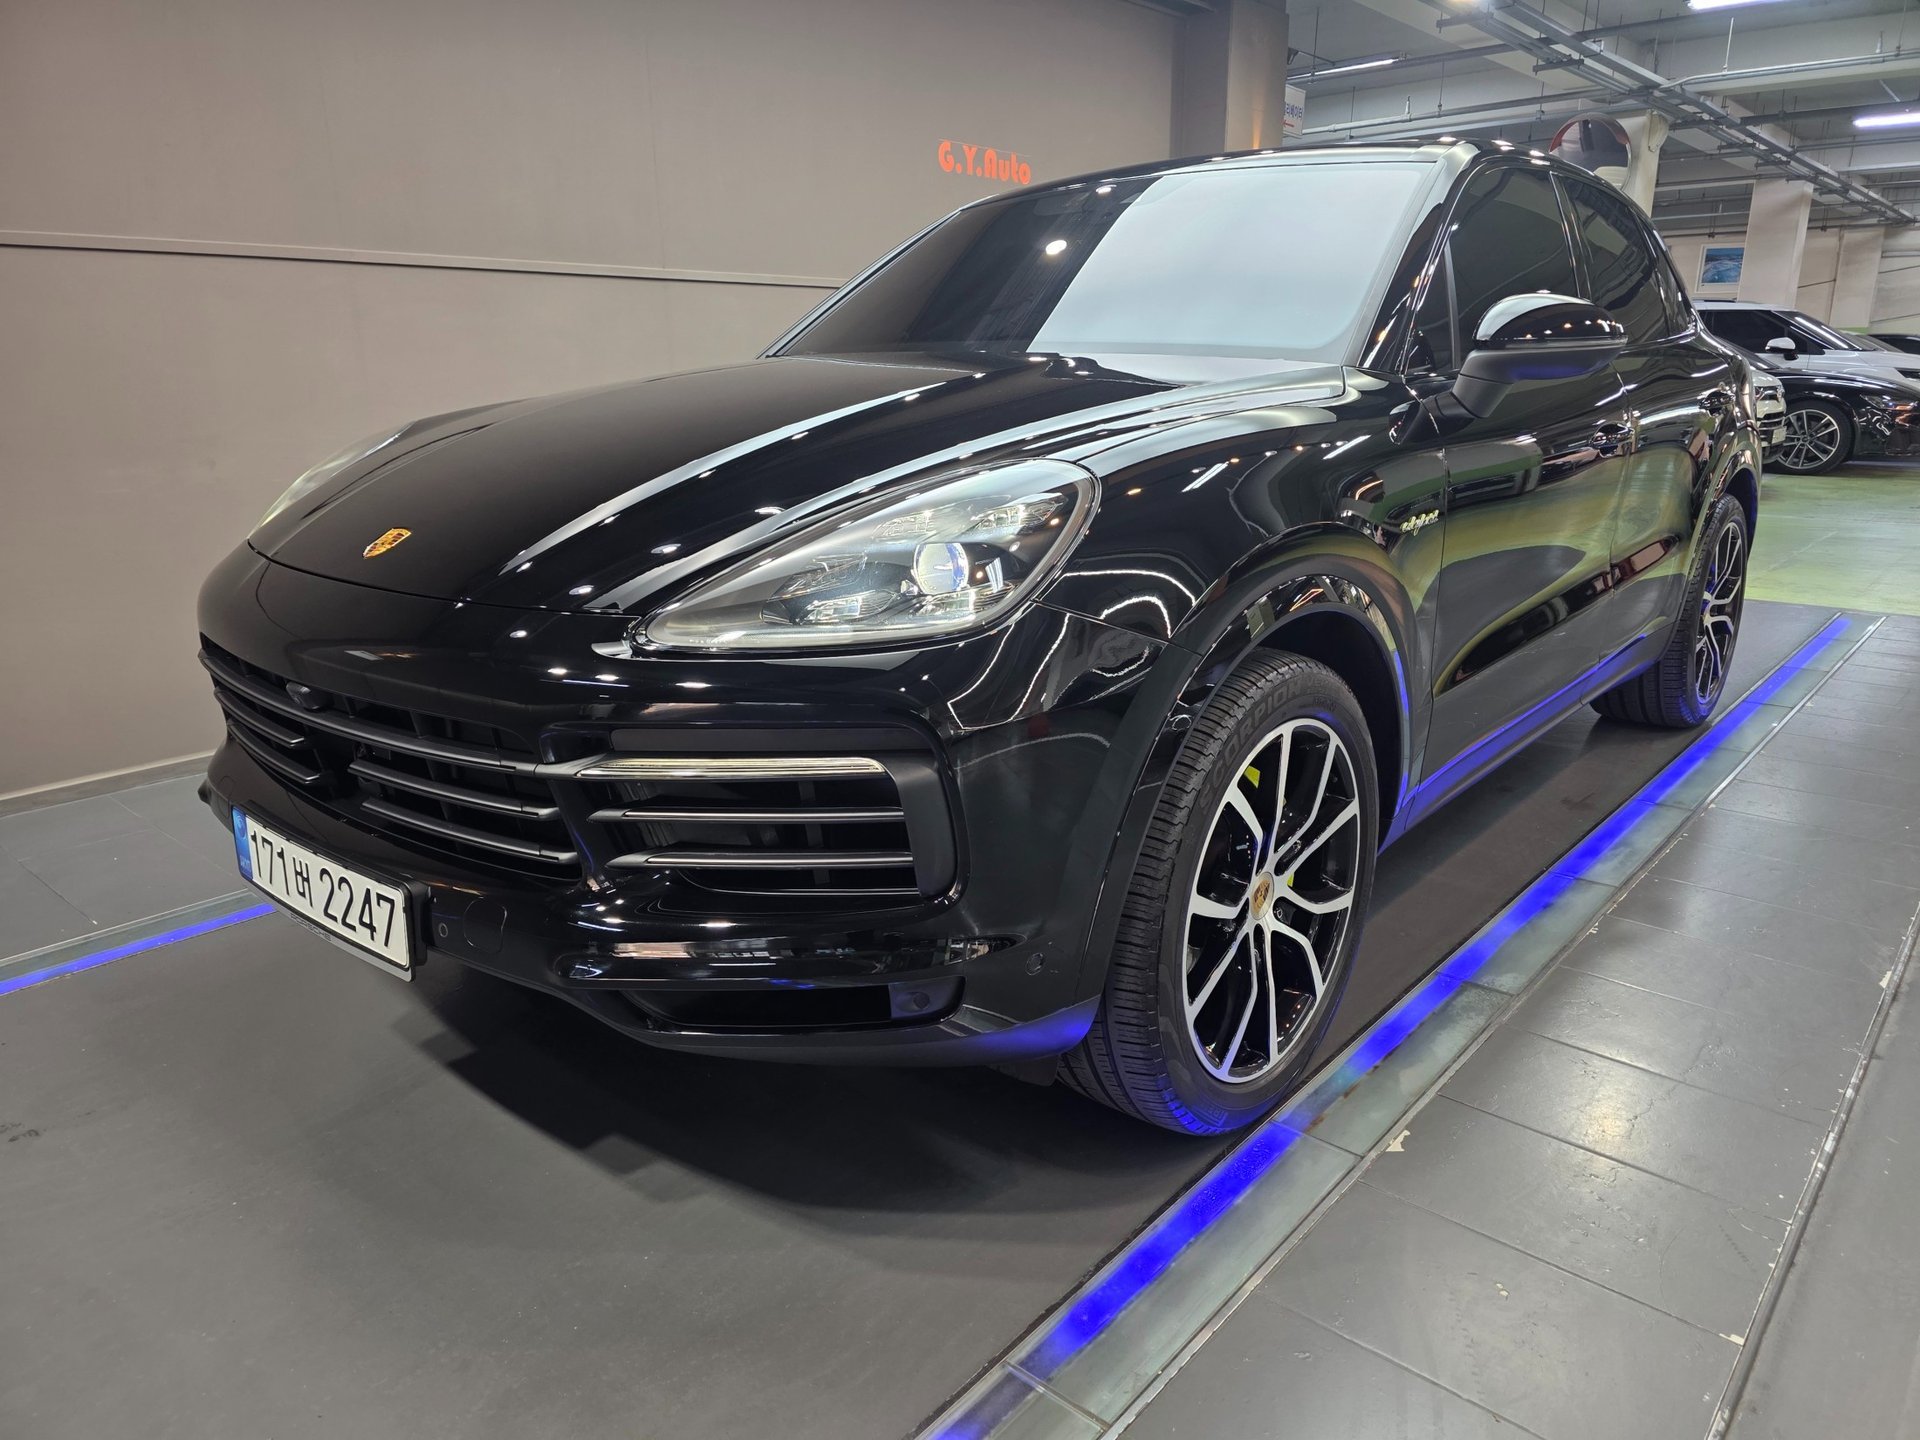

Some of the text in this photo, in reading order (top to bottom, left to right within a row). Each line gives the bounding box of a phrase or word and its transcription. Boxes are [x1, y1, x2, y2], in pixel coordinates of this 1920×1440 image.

[938, 139, 1031, 185] G.Y.Auto
[1199, 678, 1302, 815] SCORPION
[251, 830, 395, 948] 171버 2247
